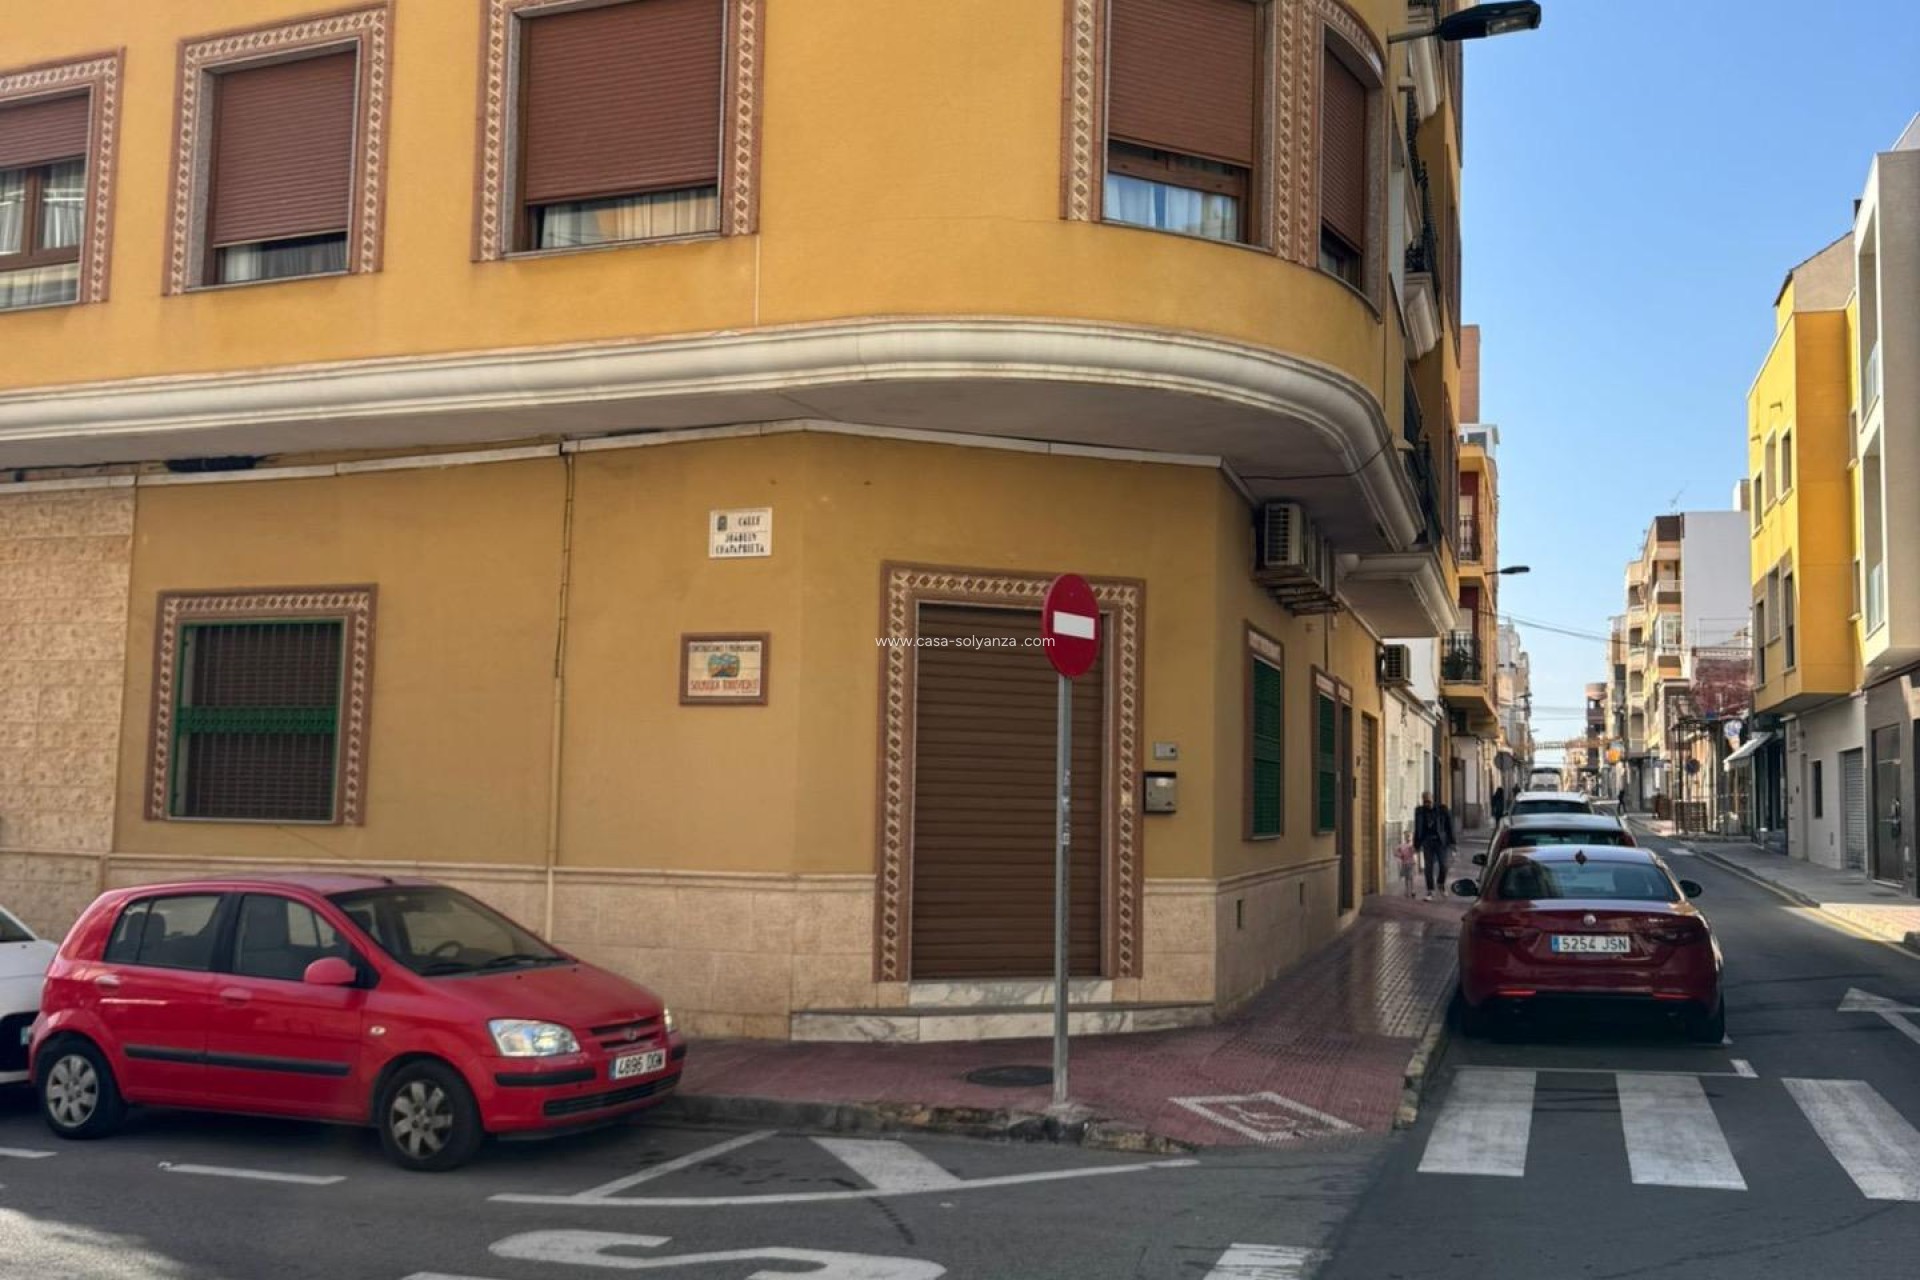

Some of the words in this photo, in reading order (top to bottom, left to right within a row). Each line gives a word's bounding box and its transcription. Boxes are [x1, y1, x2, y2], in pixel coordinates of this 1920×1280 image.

[738, 515, 761, 527] CALLE
[1562, 937, 1595, 950] 5254
[1602, 937, 1627, 950] JSN
